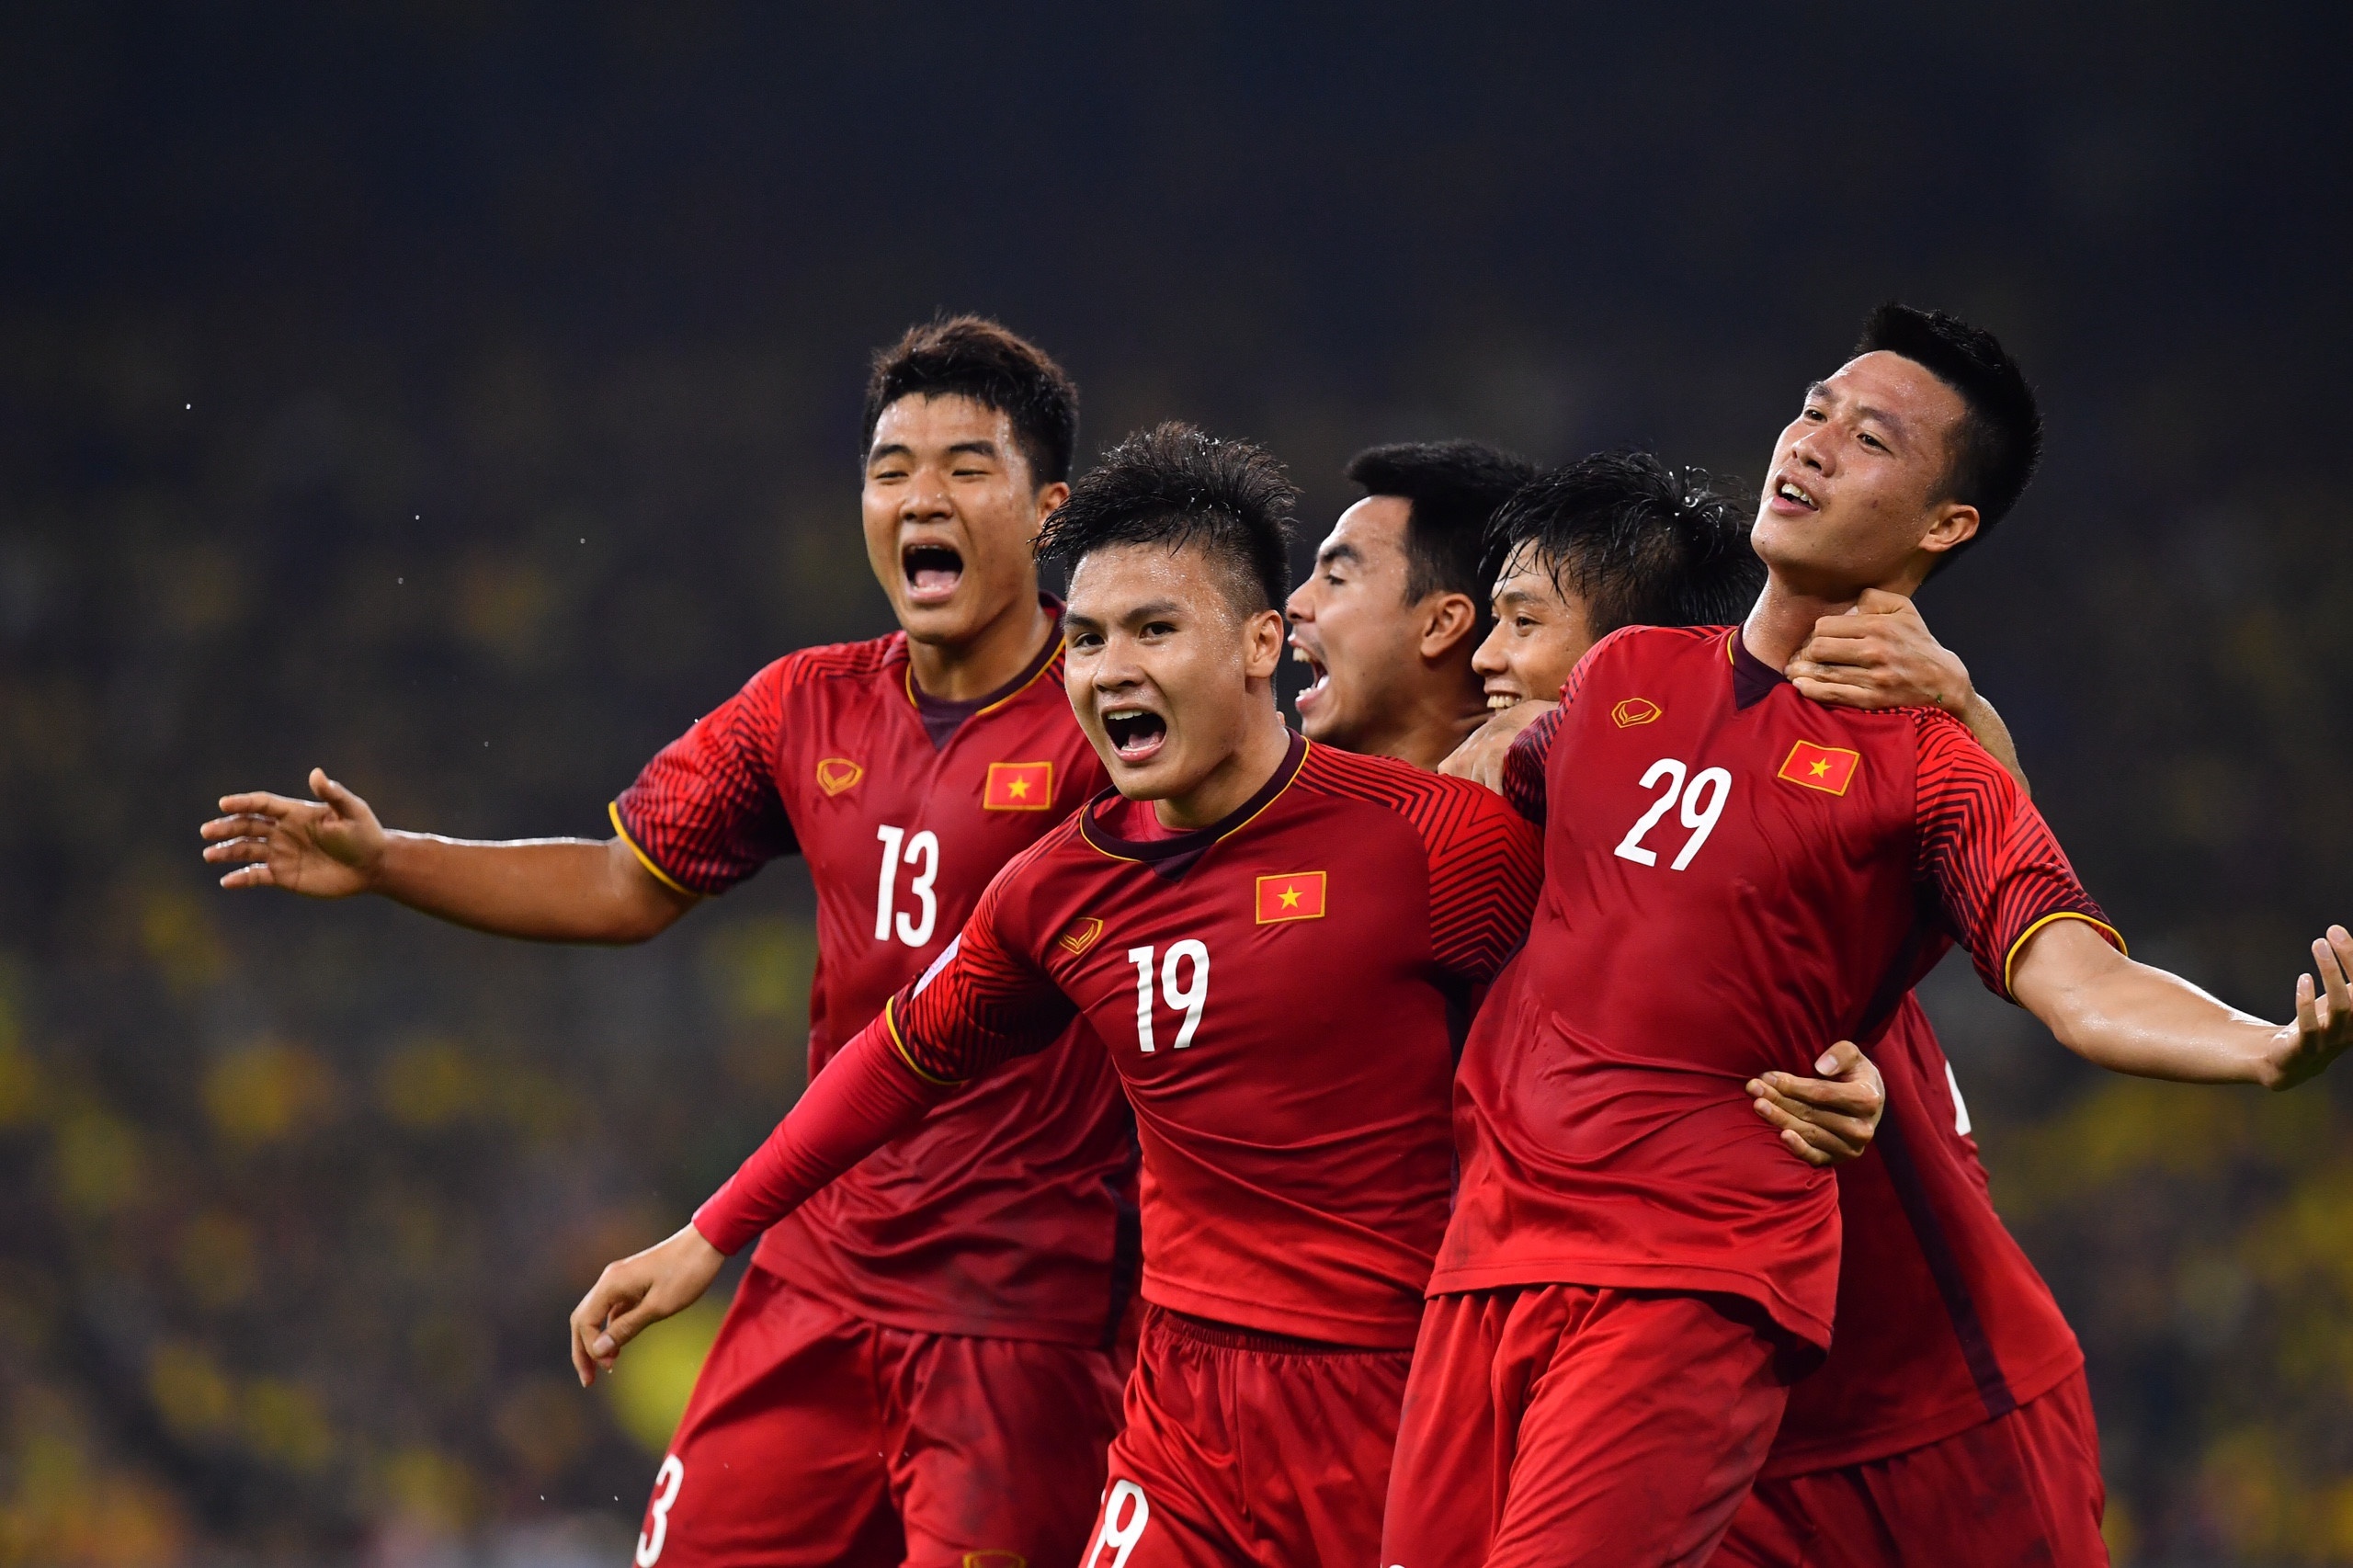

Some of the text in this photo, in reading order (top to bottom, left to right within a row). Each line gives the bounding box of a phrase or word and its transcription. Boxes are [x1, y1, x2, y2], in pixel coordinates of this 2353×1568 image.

[1613, 757, 1733, 871] 29
[874, 824, 939, 948] 13
[1128, 938, 1211, 1052] 19
